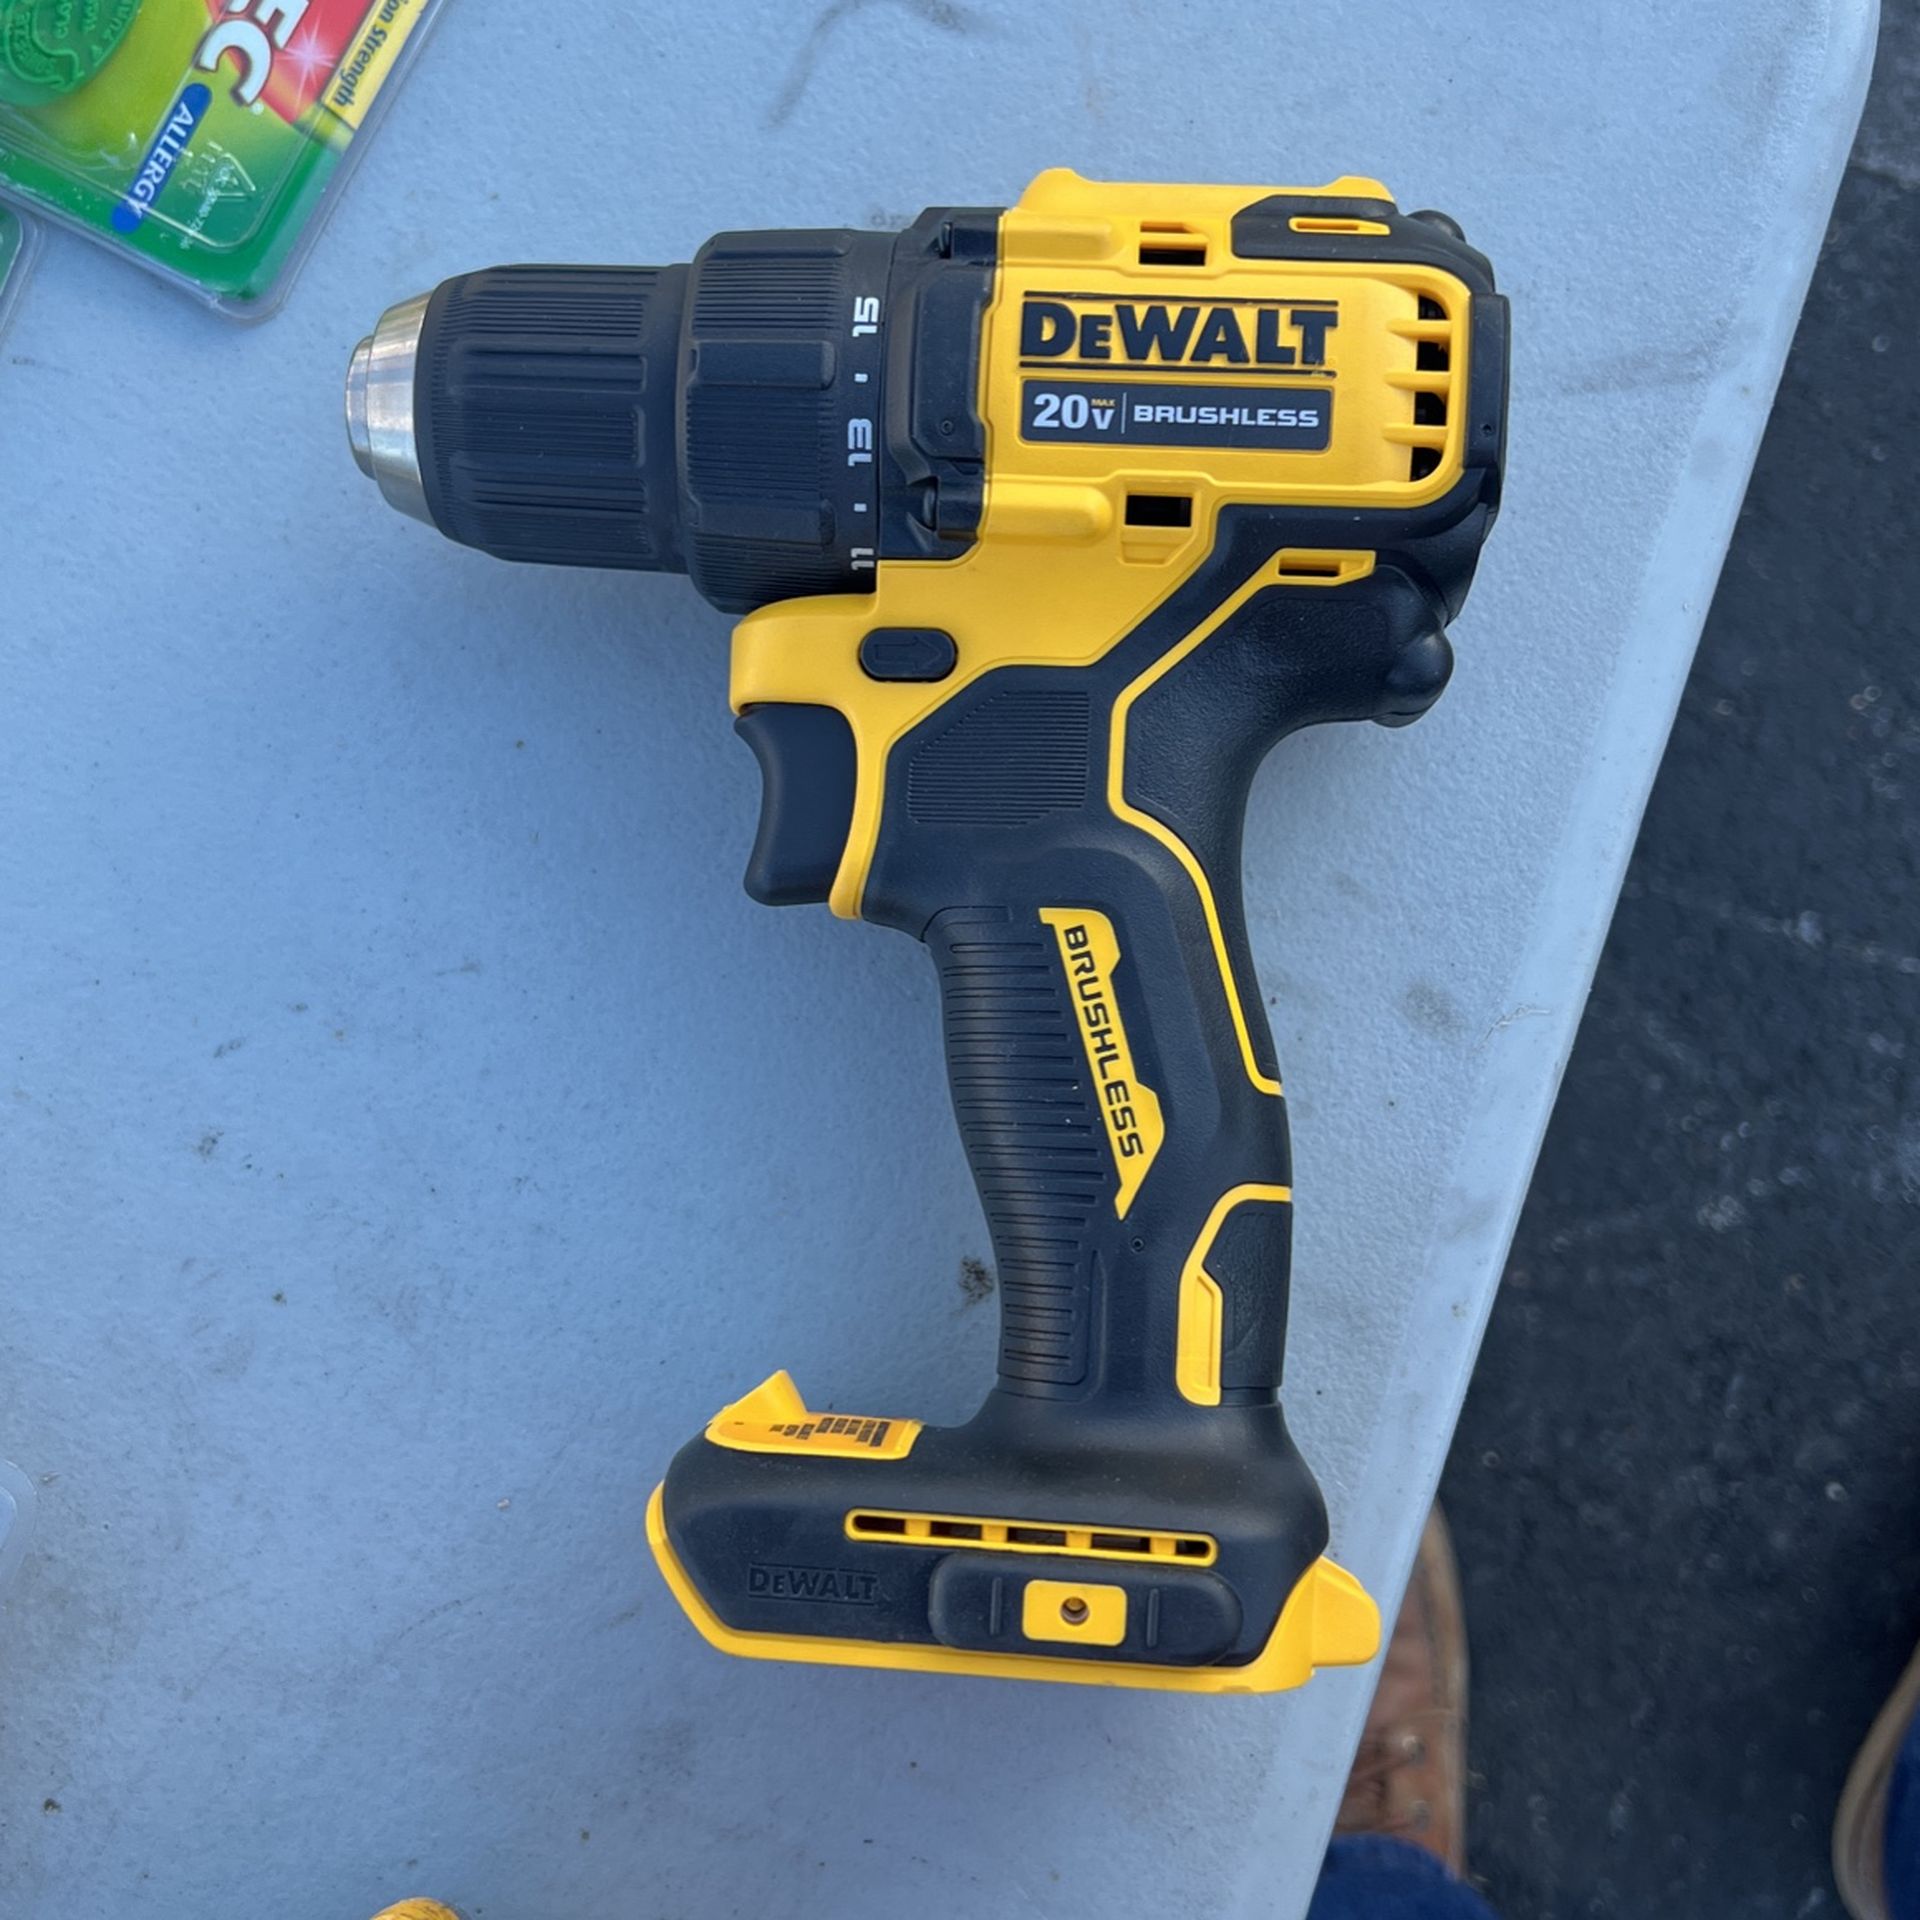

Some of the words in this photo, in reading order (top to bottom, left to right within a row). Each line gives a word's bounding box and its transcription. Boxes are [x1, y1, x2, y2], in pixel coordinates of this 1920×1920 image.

[332, 25, 389, 108] Strength
[126, 101, 196, 218] ALLERGY
[852, 296, 880, 338] 15
[847, 417, 873, 467] 13
[1133, 404, 1320, 428] BRUSHLESS
[1063, 924, 1145, 1159] BRUSHLESS
